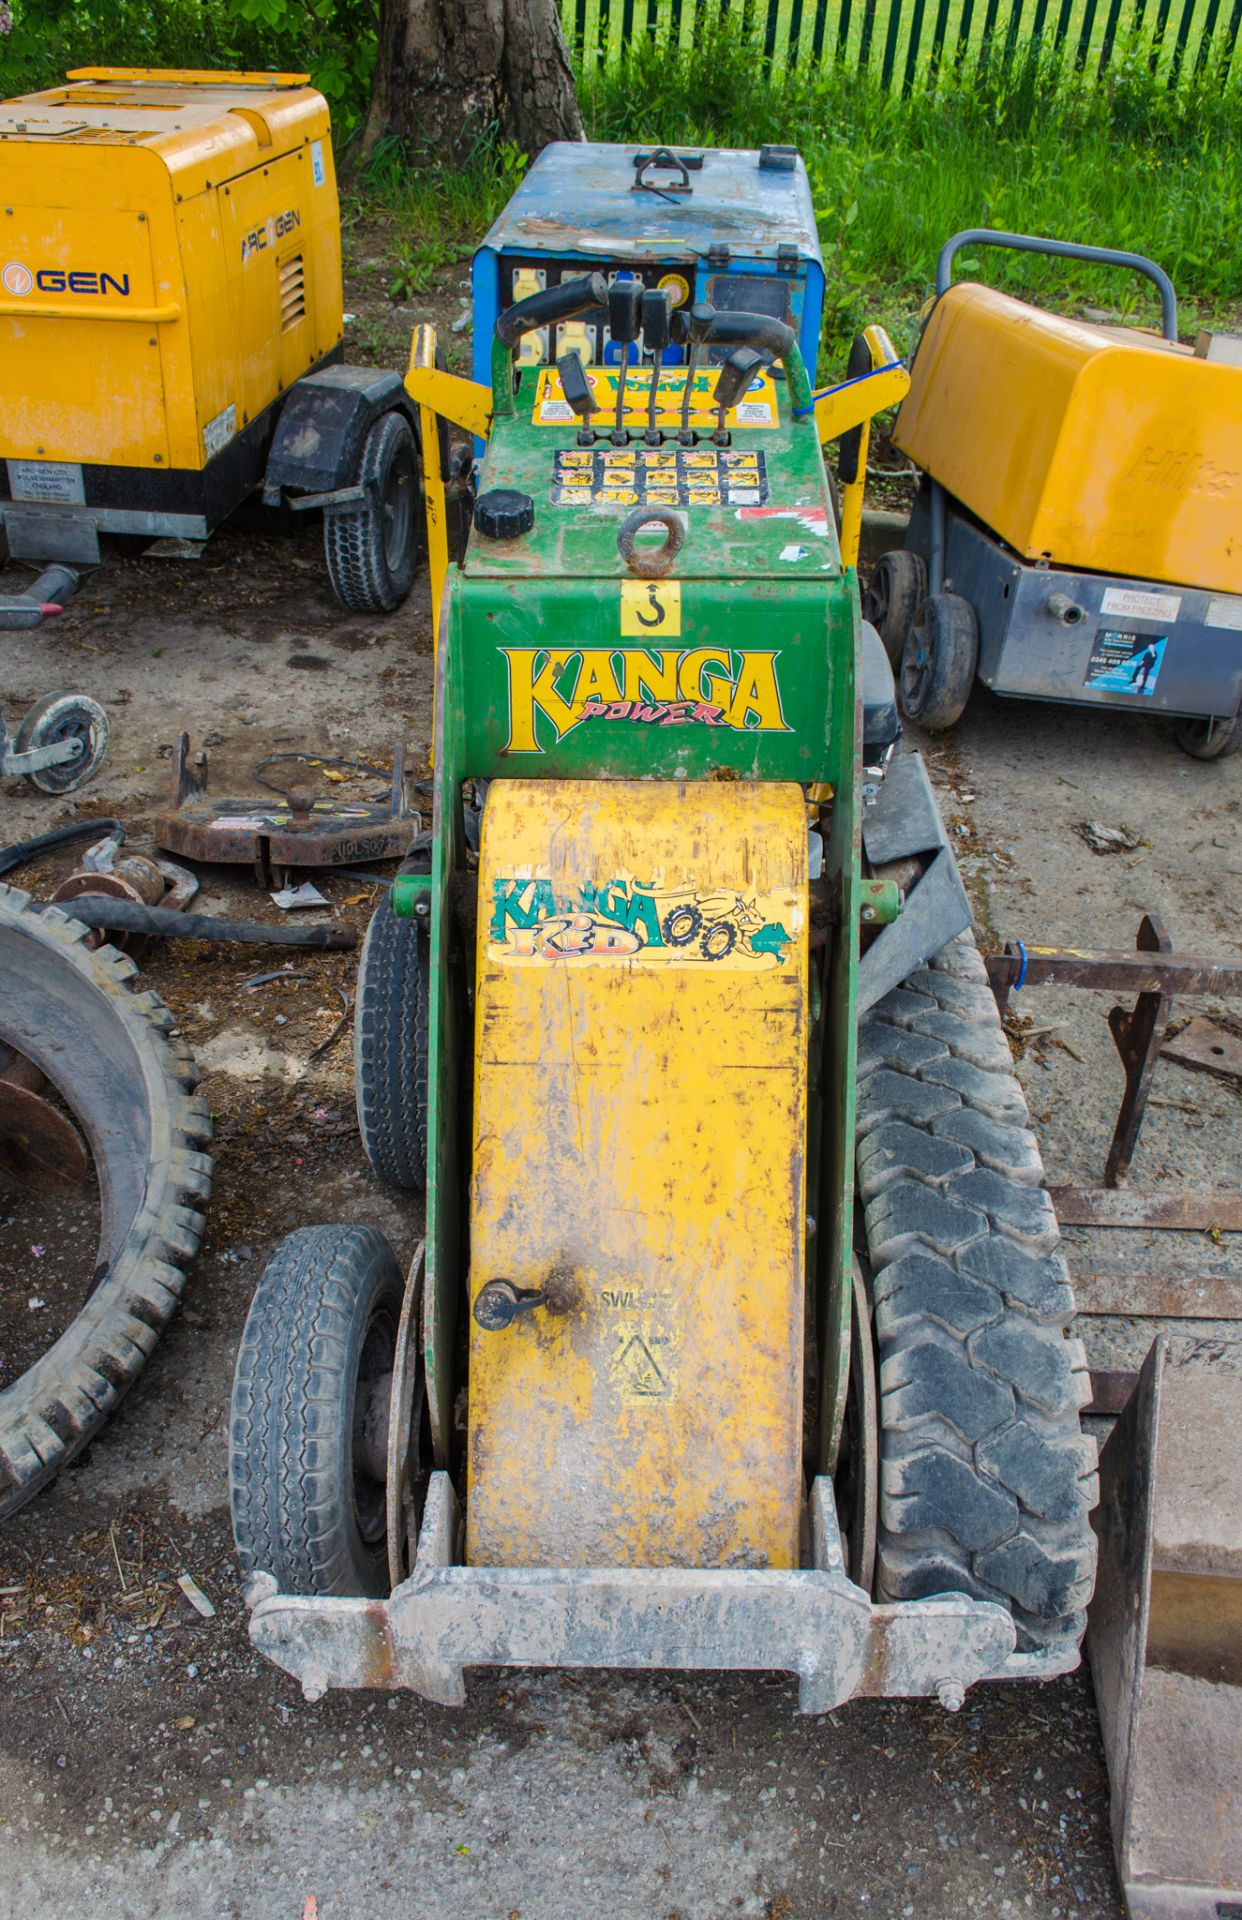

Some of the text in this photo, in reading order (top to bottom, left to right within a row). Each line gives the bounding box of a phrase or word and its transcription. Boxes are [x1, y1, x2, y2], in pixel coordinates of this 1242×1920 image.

[276, 208, 301, 238] GEN
[36, 270, 130, 296] GEN
[1106, 602, 1130, 611] FROM
[1123, 594, 1161, 605] PROTECT
[497, 647, 795, 753] KANGA
[576, 700, 730, 726] POWER
[489, 879, 668, 947] KANGA
